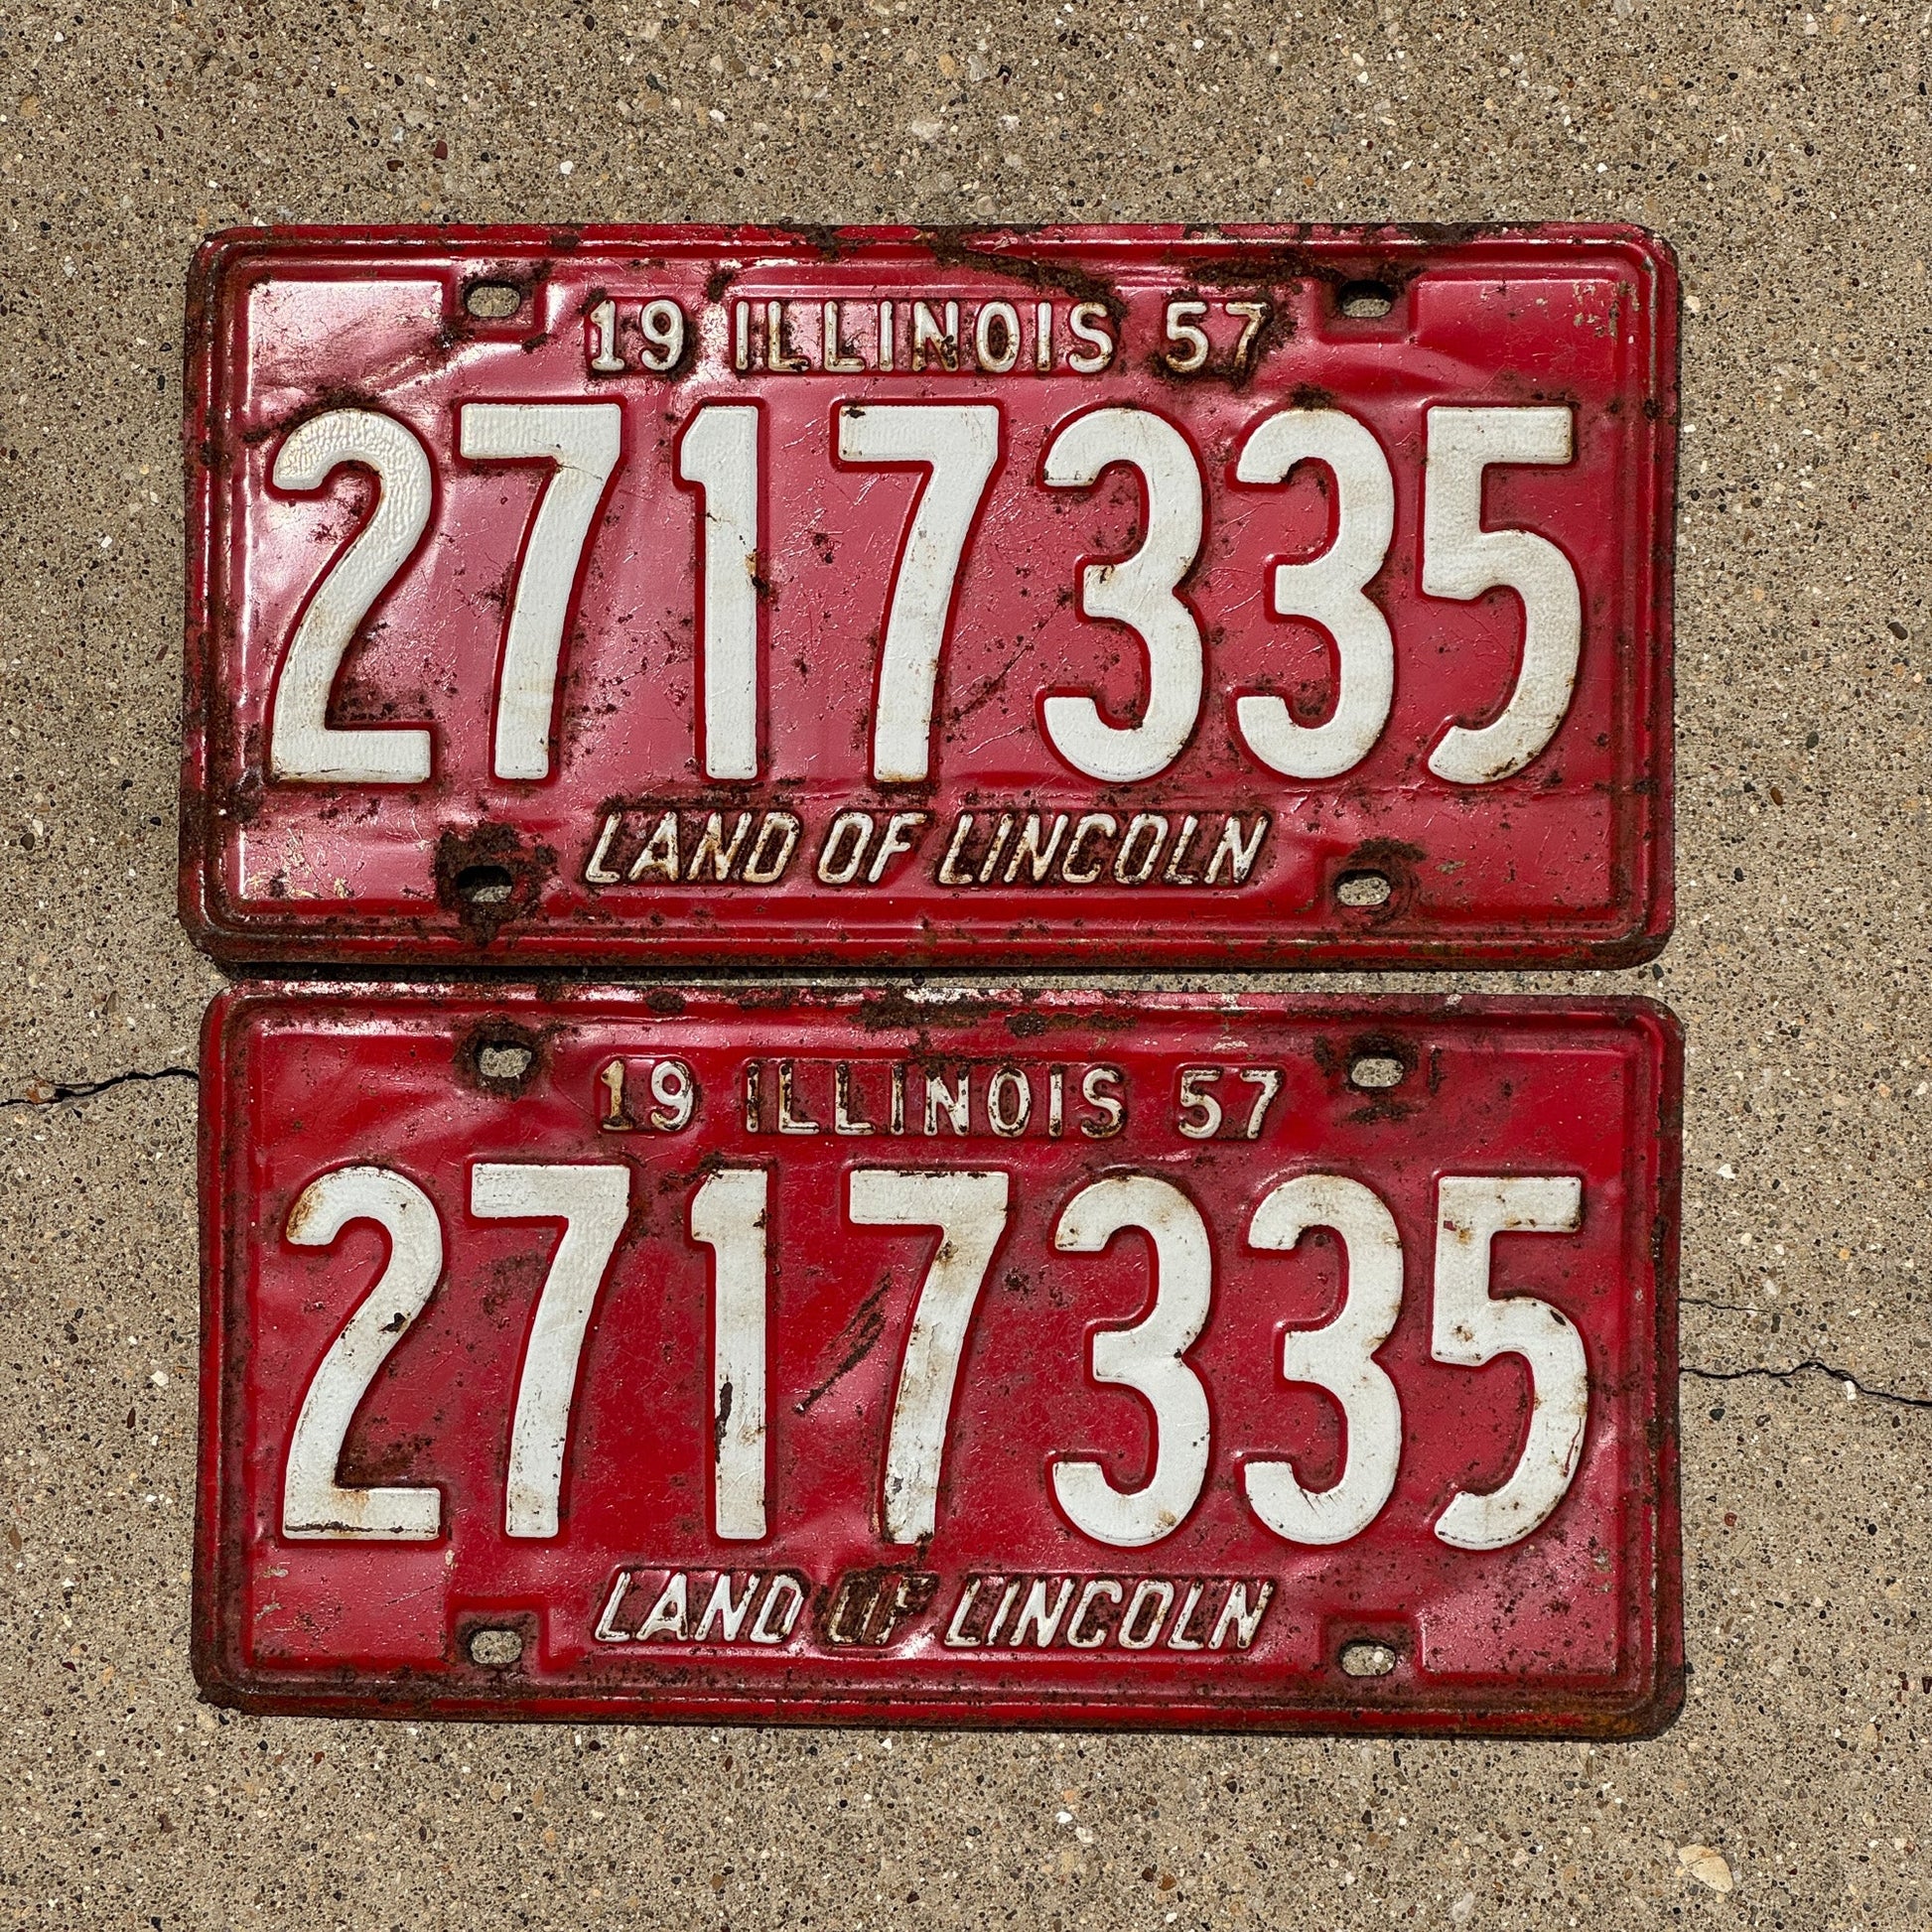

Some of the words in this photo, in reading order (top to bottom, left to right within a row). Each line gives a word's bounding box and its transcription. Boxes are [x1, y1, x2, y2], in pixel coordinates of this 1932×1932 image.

[591, 301, 682, 370] 19
[736, 302, 1114, 373] ILLINOIS
[1166, 303, 1267, 370] 57
[269, 403, 1583, 785] 2717335
[586, 811, 799, 883] LAND
[818, 811, 925, 883] OF
[939, 813, 1268, 885] LINCOLN
[600, 1061, 693, 1131] 19
[746, 1062, 1124, 1137] ILLINOIS
[1178, 1069, 1279, 1139] 57
[282, 1163, 1590, 1549] 2717335
[595, 1572, 804, 1643] LAND
[828, 1572, 934, 1645] OF
[946, 1576, 1272, 1650] LINCOLN
